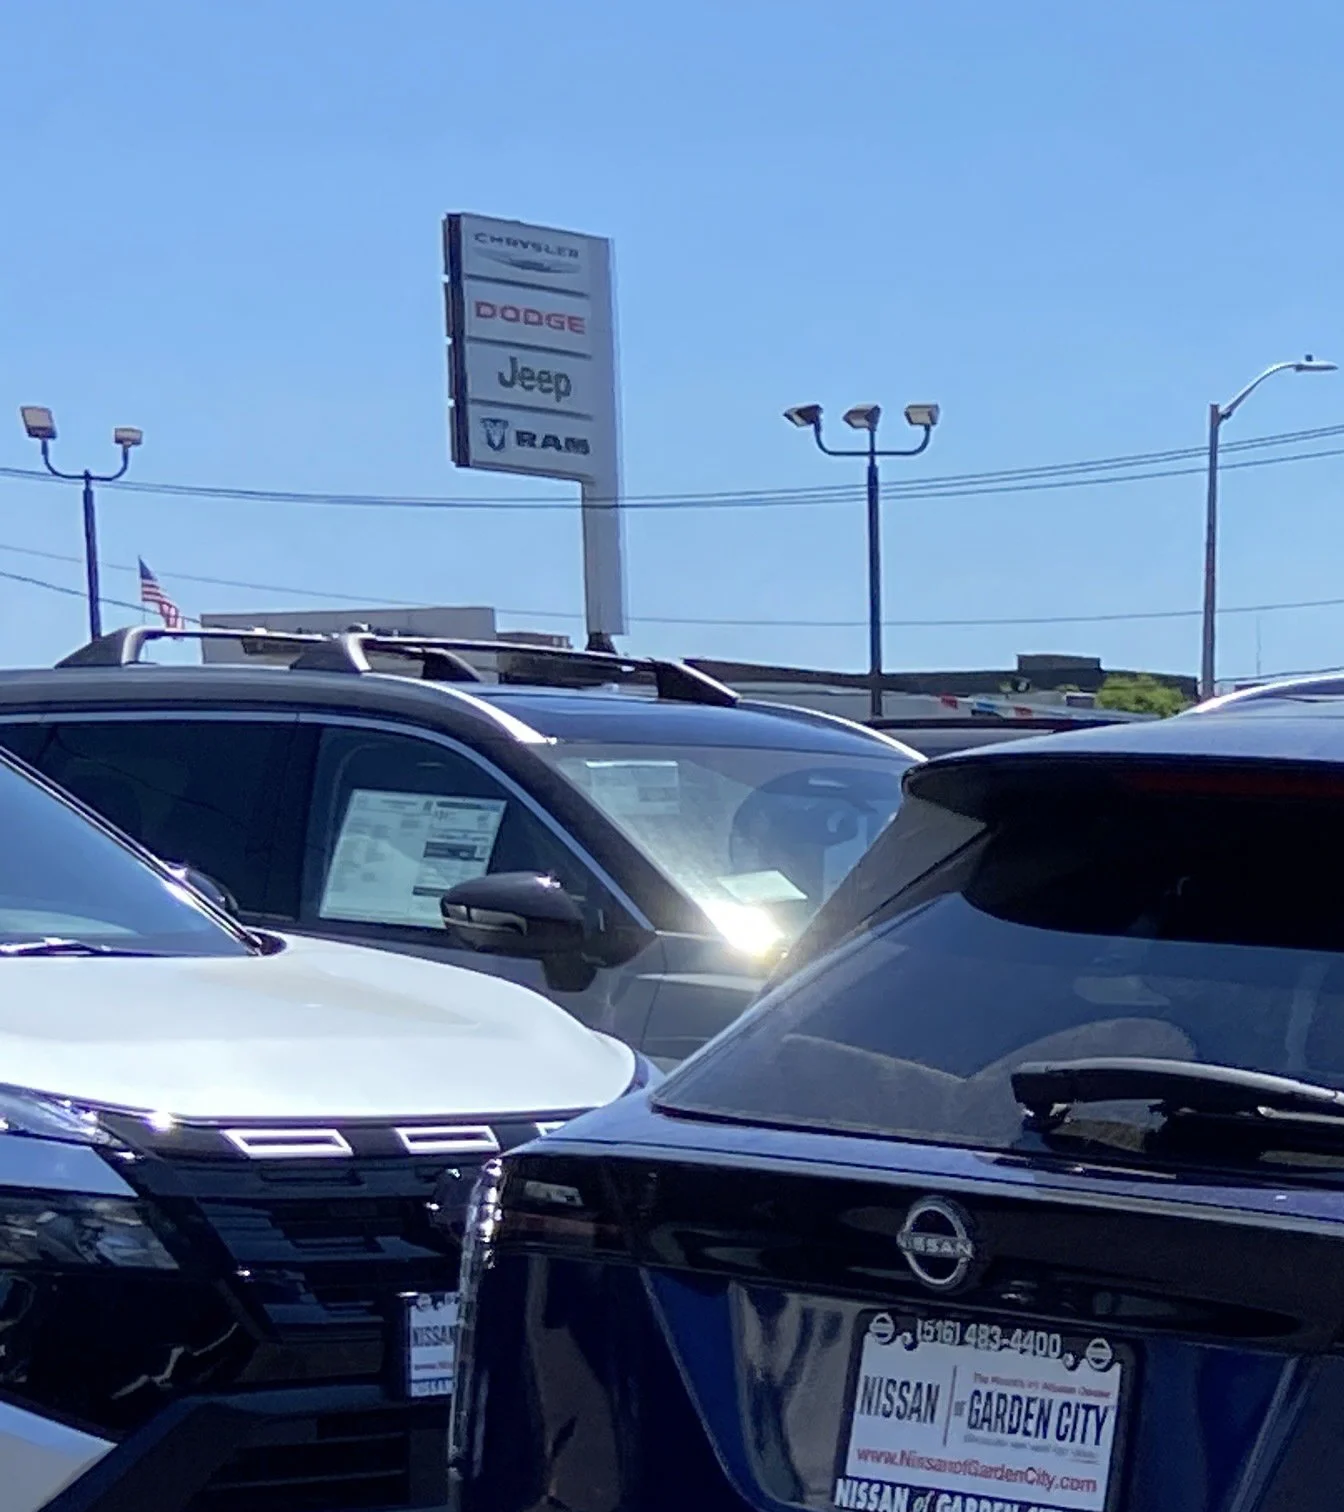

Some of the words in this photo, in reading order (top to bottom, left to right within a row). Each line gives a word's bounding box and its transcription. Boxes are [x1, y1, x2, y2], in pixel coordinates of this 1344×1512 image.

[474, 233, 579, 258] CHRYSLER
[475, 301, 585, 334] DODGE
[498, 356, 572, 402] Jeep
[515, 430, 591, 456] RAM
[964, 1324, 1063, 1360] 483-4400
[859, 1374, 940, 1425] NISSAN
[967, 1388, 1054, 1440] GARDEN
[1055, 1400, 1109, 1447] CITY
[856, 1446, 1098, 1493] www.NissanofGardenCity.com
